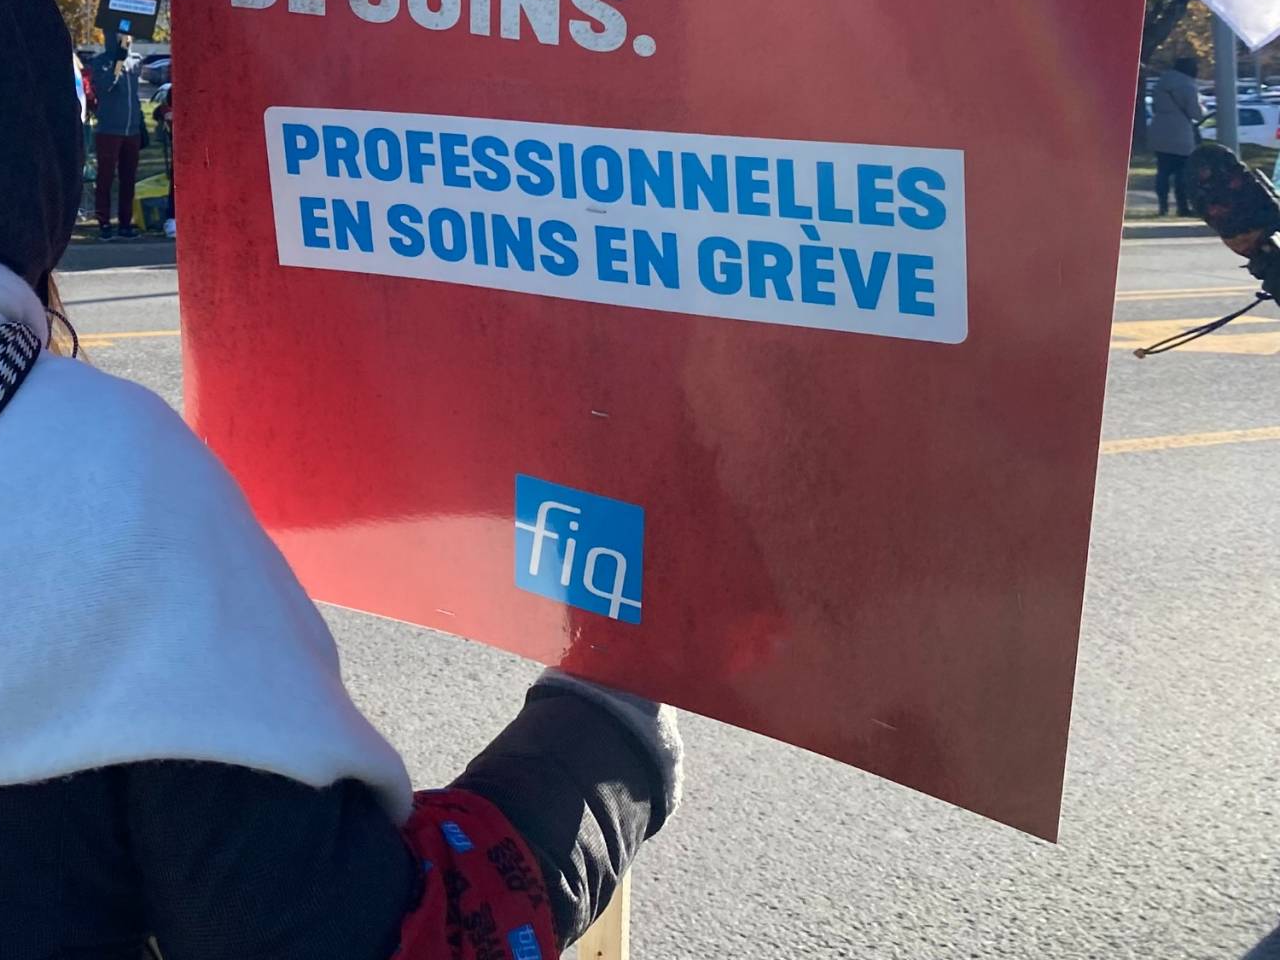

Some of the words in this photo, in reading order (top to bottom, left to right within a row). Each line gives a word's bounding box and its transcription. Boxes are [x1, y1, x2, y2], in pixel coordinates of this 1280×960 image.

[282, 123, 947, 230] PROFESSIONNELLES
[299, 196, 374, 252] EN
[387, 203, 579, 277] SOINS
[595, 225, 680, 289] EN
[697, 224, 935, 317] GRÈVE
[515, 501, 642, 620] fiq
